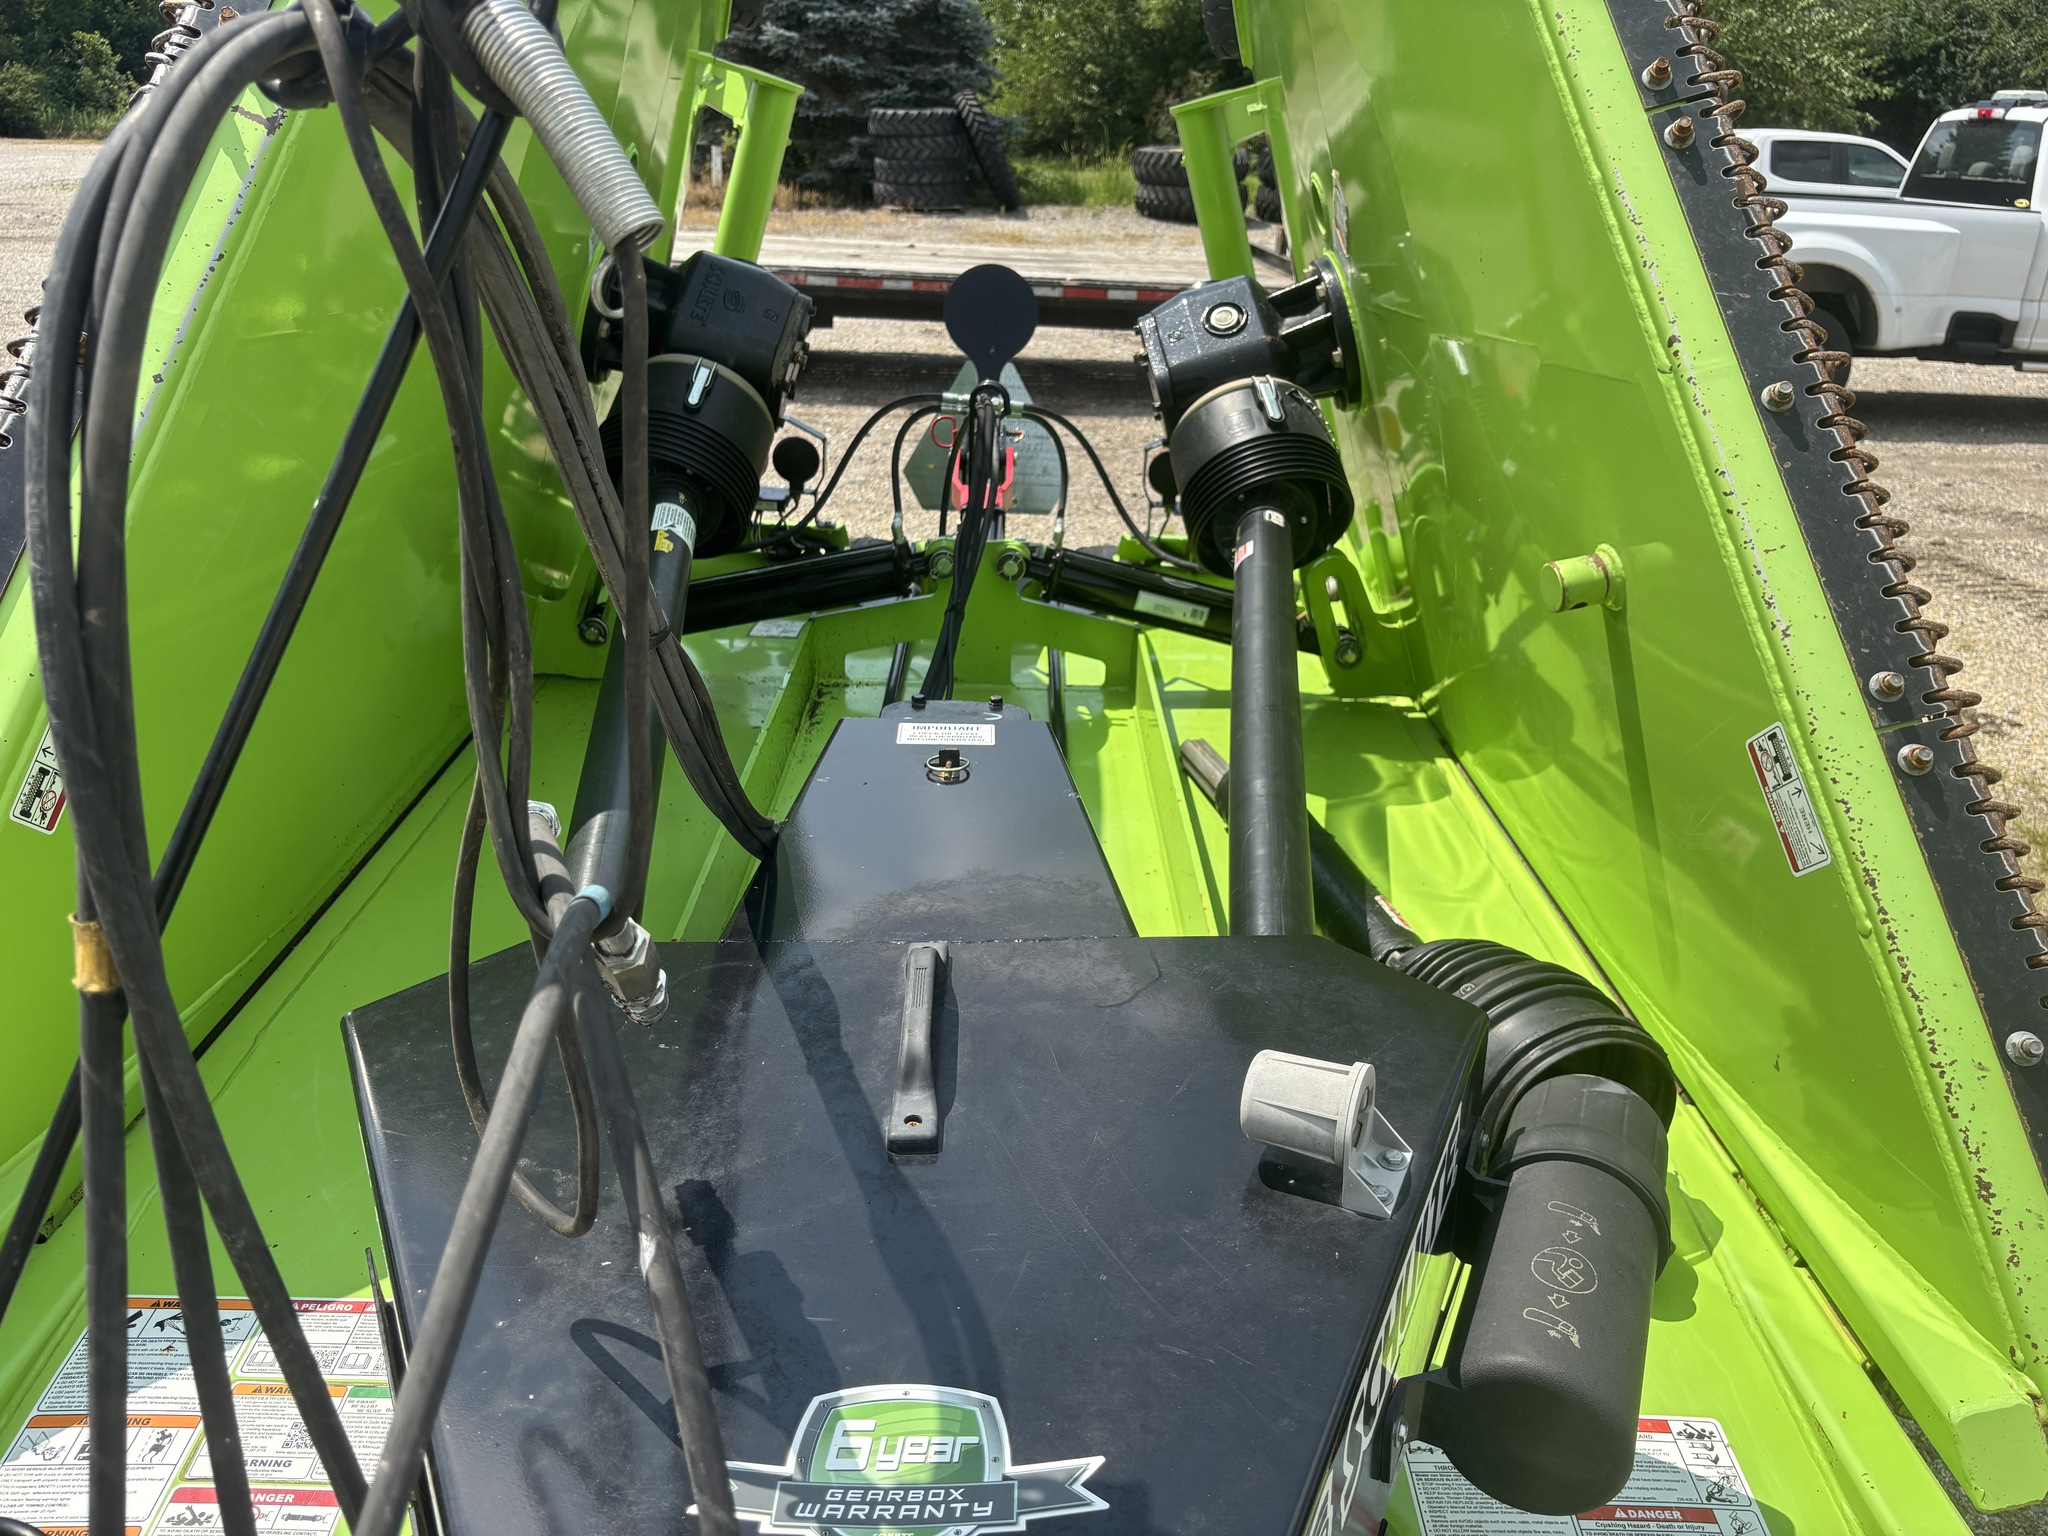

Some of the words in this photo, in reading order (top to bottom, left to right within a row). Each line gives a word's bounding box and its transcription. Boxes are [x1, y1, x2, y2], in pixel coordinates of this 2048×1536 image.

[1764, 786, 1781, 823] DANGER
[1799, 807, 1813, 834] HERE
[300, 1303, 354, 1312] PELIGRO
[825, 1419, 877, 1472] 6
[876, 1435, 980, 1472] year
[826, 1488, 966, 1501] GEARBOX
[795, 1500, 994, 1518] WARRANTY
[1627, 1509, 1683, 1520] DANGER
[1595, 1521, 1626, 1530] Crushing
